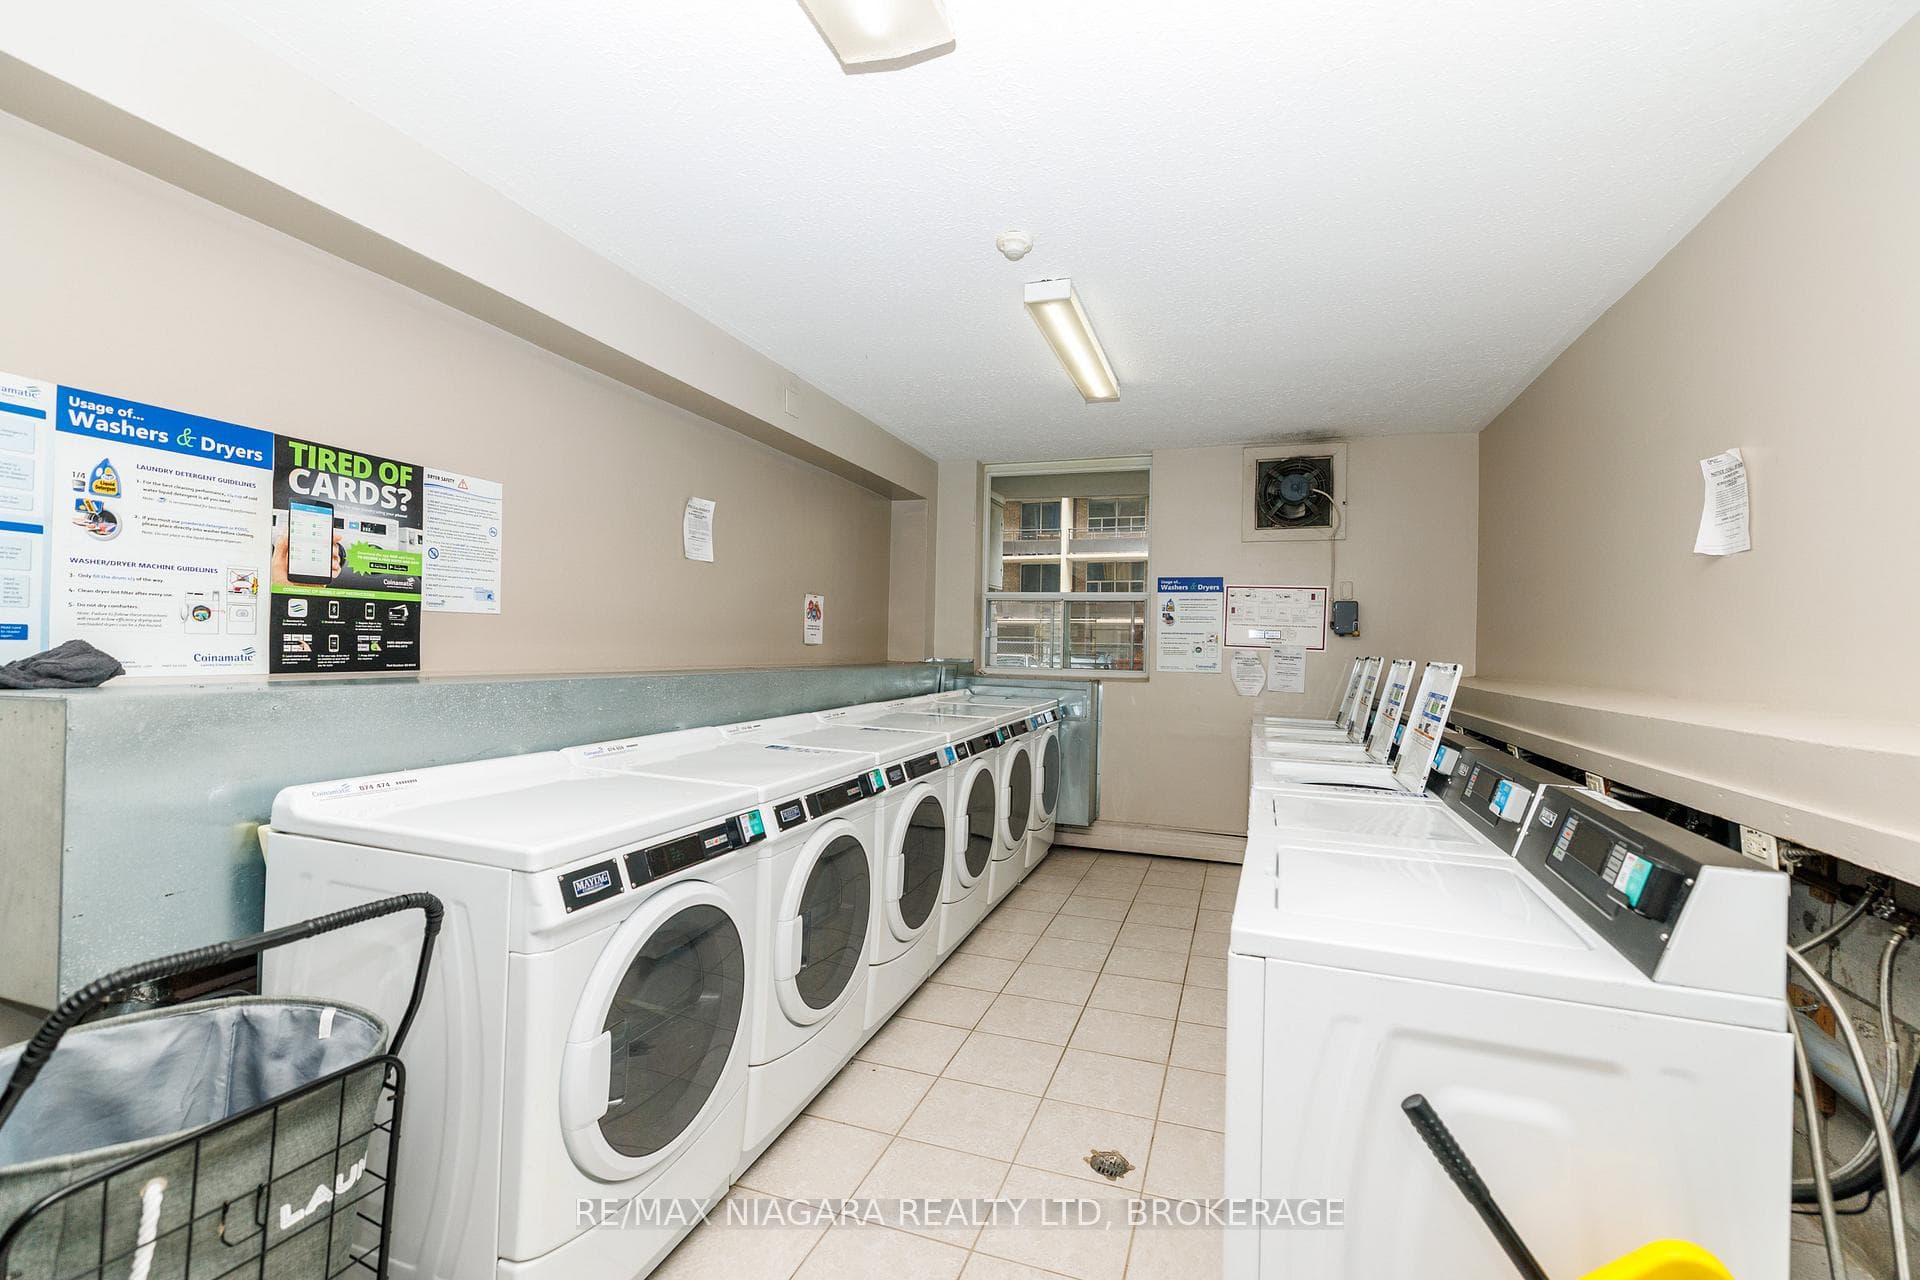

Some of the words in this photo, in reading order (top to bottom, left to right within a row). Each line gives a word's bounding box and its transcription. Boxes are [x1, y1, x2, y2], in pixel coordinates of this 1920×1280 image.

[68, 396, 114, 415] Usage
[118, 408, 144, 421] of...
[68, 409, 168, 443] Washers
[176, 428, 197, 447] &
[201, 436, 263, 461] Dryers
[136, 464, 173, 475] LAUNDRY
[176, 470, 216, 482] DETERGENT
[218, 477, 256, 488] GUIDELINES
[289, 441, 372, 479] TIRED
[379, 462, 412, 487] OF
[289, 468, 412, 511] CARDS?
[69, 557, 138, 568] WASHER/DRYER
[139, 562, 174, 571] MACHINE
[177, 565, 218, 574] GUIDELINES
[384, 579, 414, 587] Coinamatic
[194, 653, 253, 662] Coinamatic
[576, 874, 607, 890] MAYTAG
